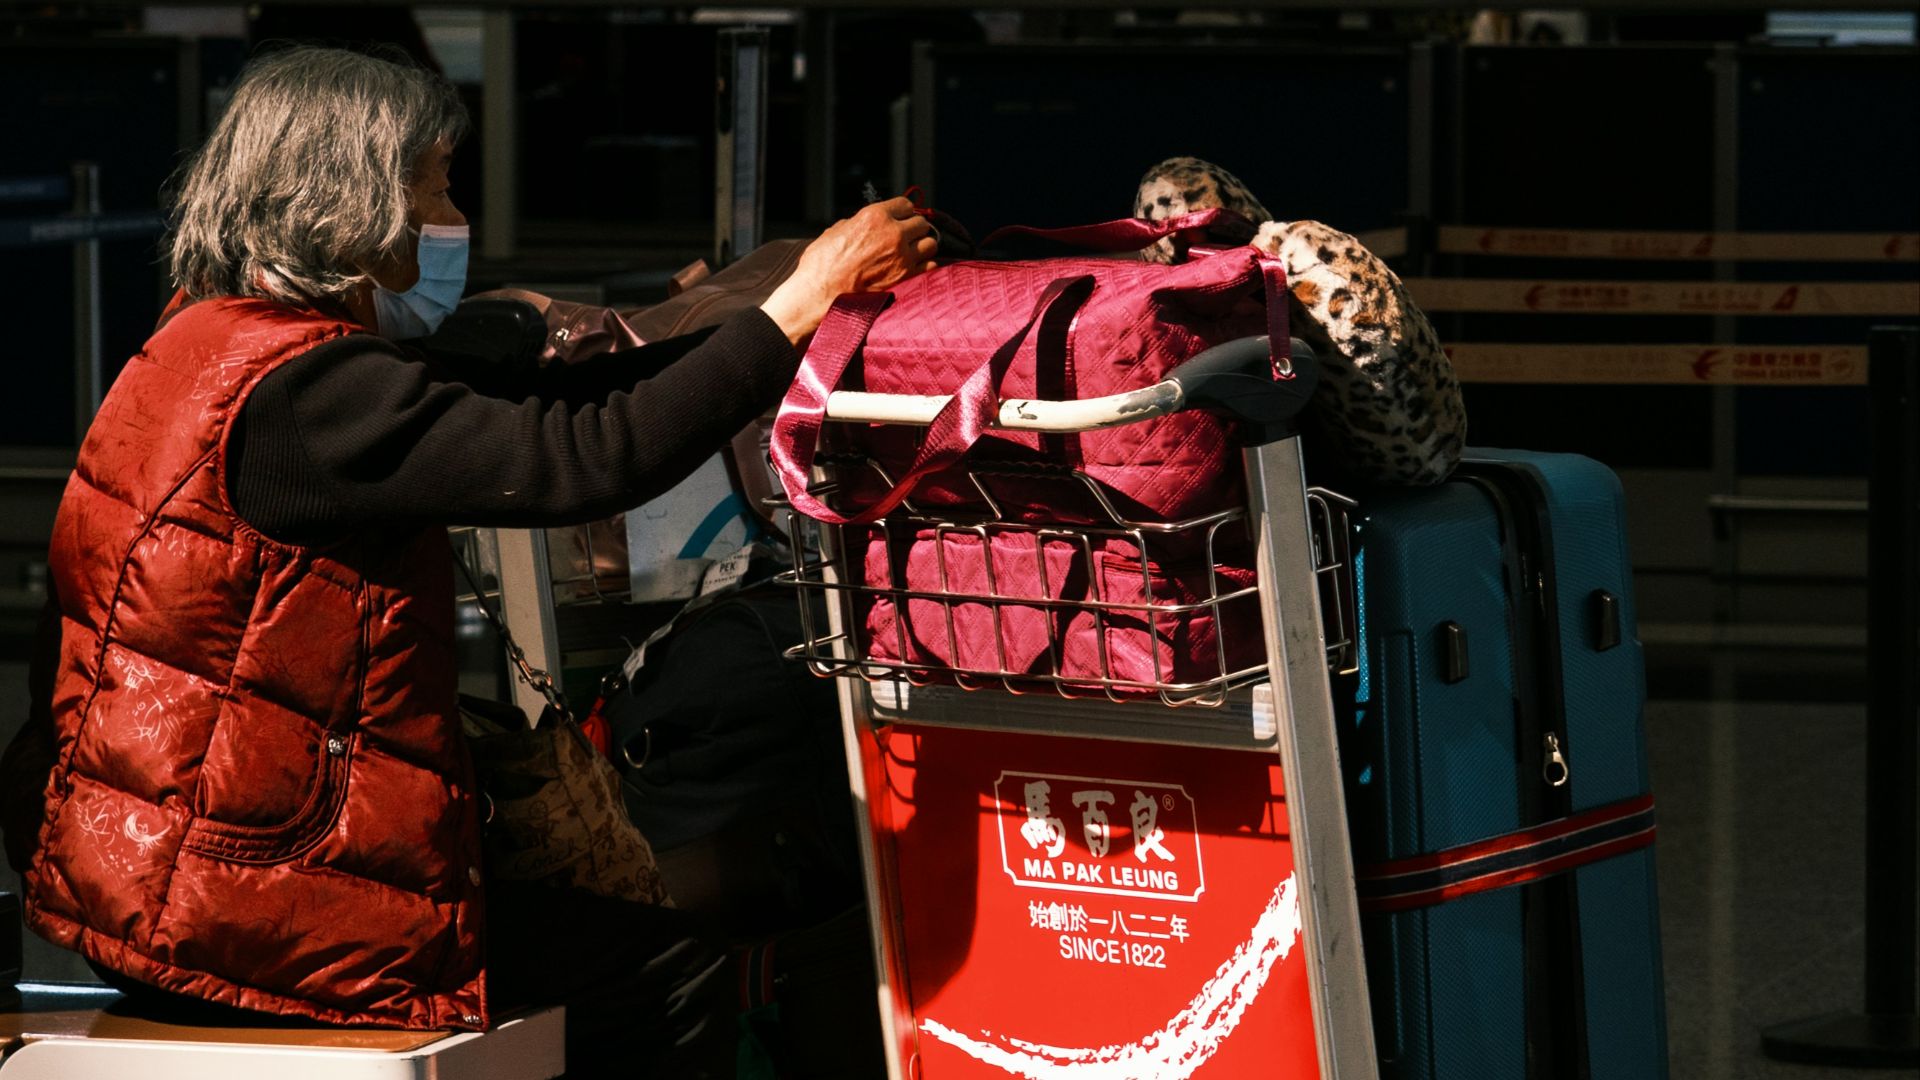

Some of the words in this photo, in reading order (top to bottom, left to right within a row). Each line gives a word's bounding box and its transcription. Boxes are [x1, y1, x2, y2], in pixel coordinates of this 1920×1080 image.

[1020, 780, 1175, 863] 馬百良
[1024, 858, 1056, 879] MA
[1062, 862, 1104, 883] PAK
[1110, 866, 1178, 890] LEUNG
[1028, 900, 1190, 943] 始創於一八二二年
